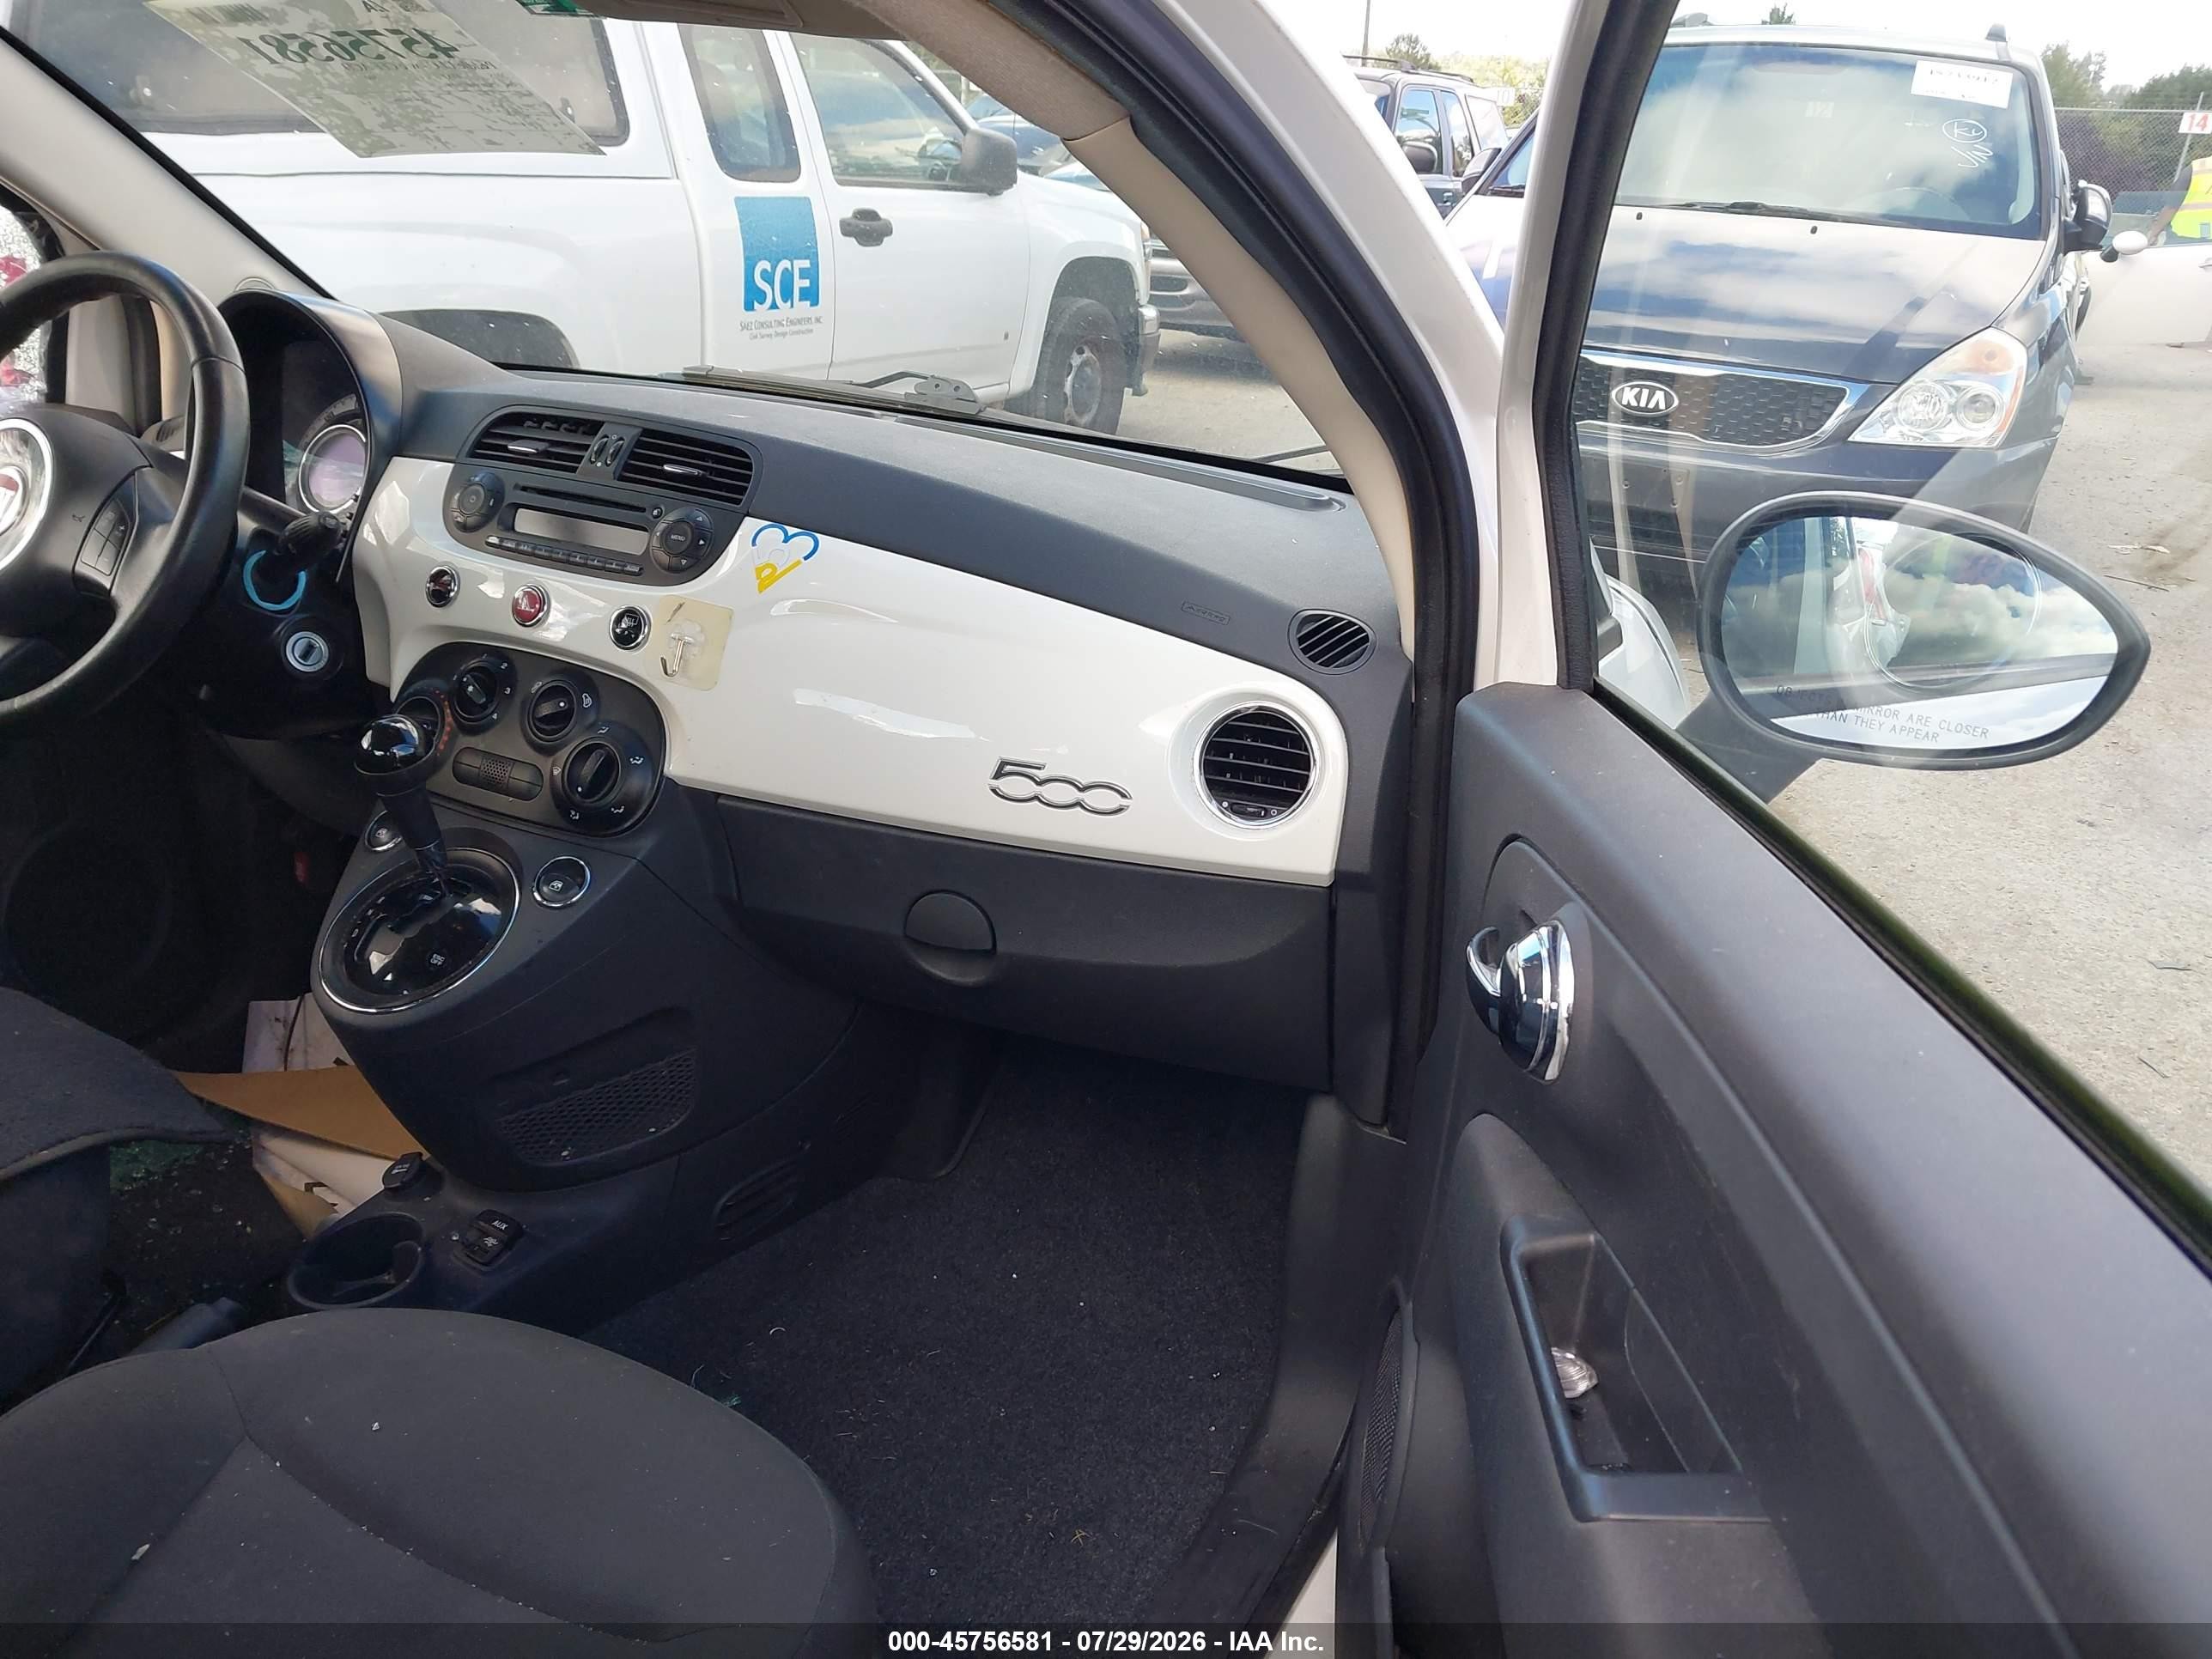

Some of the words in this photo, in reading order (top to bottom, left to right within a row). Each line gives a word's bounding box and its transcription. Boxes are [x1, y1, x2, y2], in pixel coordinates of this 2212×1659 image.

[2188, 113, 2209, 131] 14
[754, 259, 811, 310] SCE
[1622, 387, 1666, 410] KIA
[1854, 714, 1885, 731] THEY
[1889, 724, 1939, 743] APPEAR
[1907, 714, 1932, 726] ARE
[1938, 720, 1989, 739] CLOSER
[988, 757, 1133, 816] 500
[492, 1220, 508, 1231] AUX
